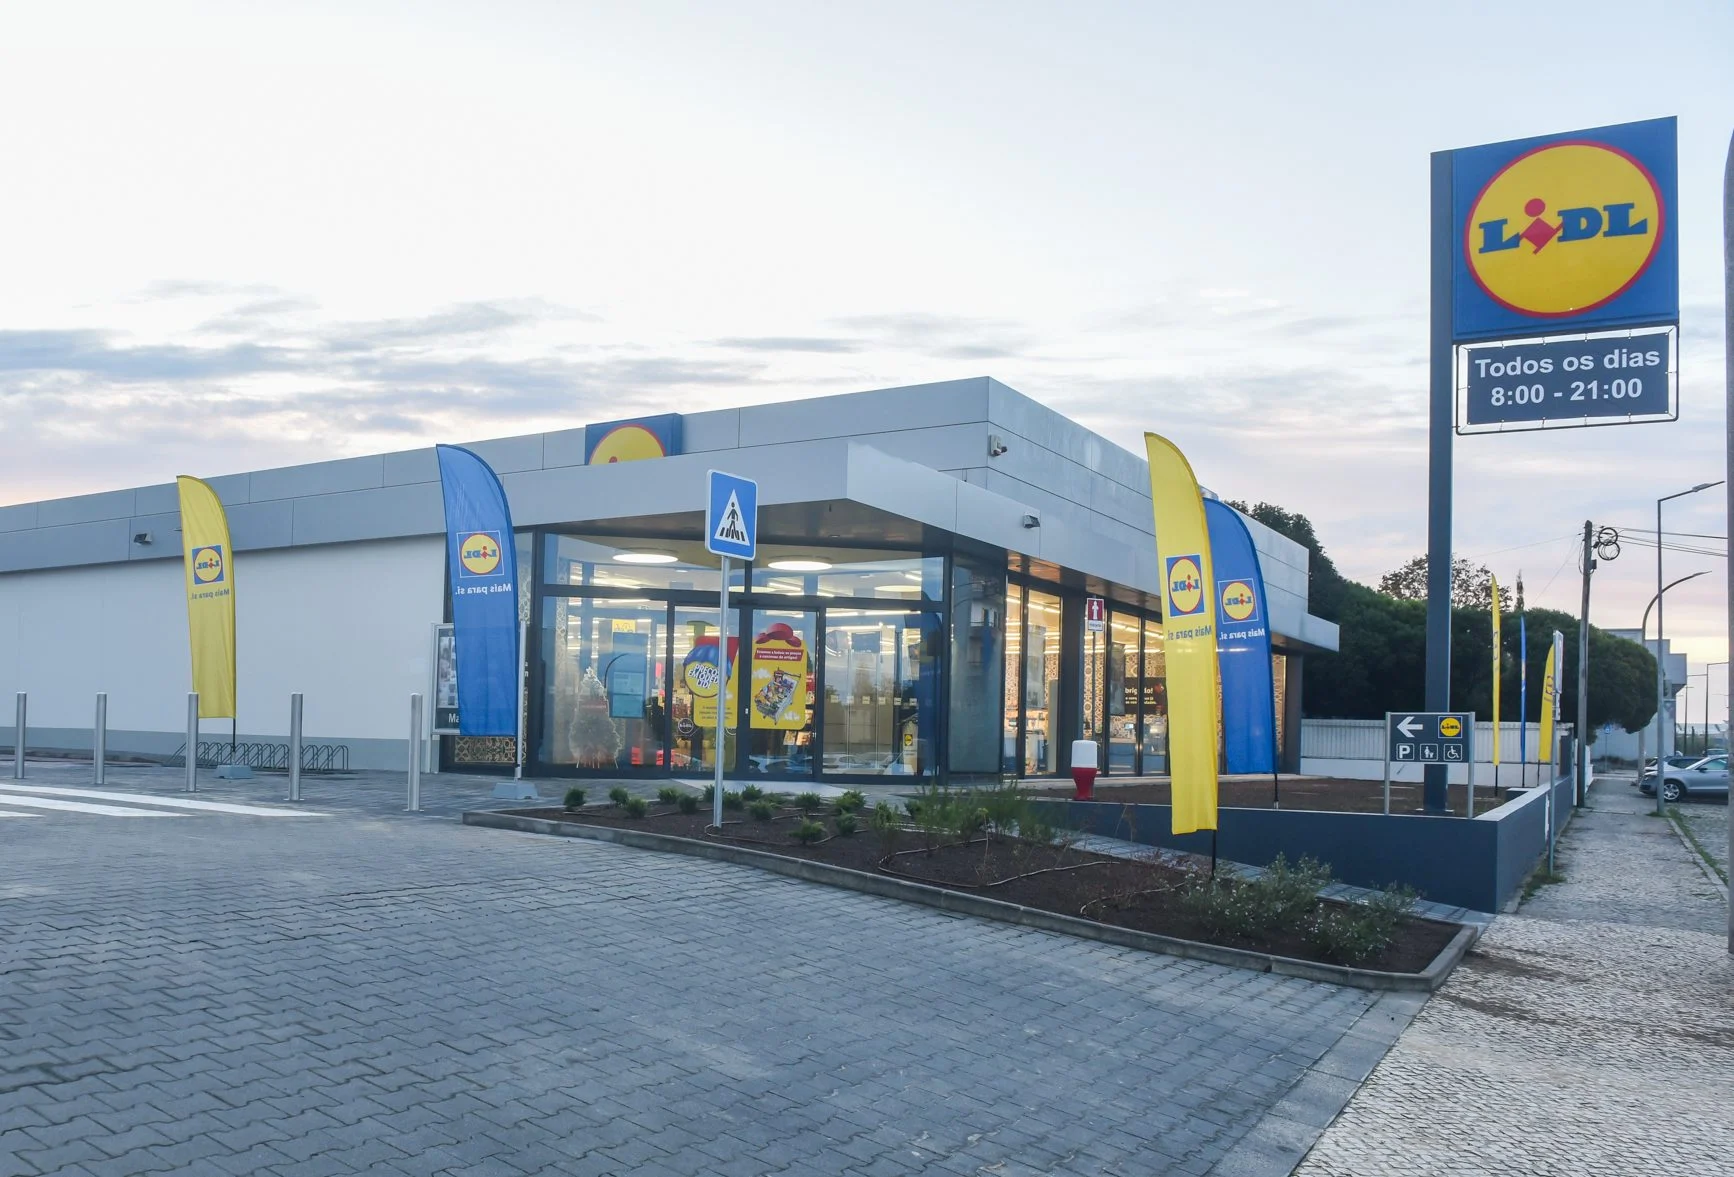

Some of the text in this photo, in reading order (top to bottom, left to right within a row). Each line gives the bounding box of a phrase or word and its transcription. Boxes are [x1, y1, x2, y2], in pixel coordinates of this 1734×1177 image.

[1474, 348, 1661, 378] Todos os dias
[1491, 384, 1545, 407] 8:00
[1570, 378, 1643, 401] 21:00
[1399, 745, 1411, 759] P
